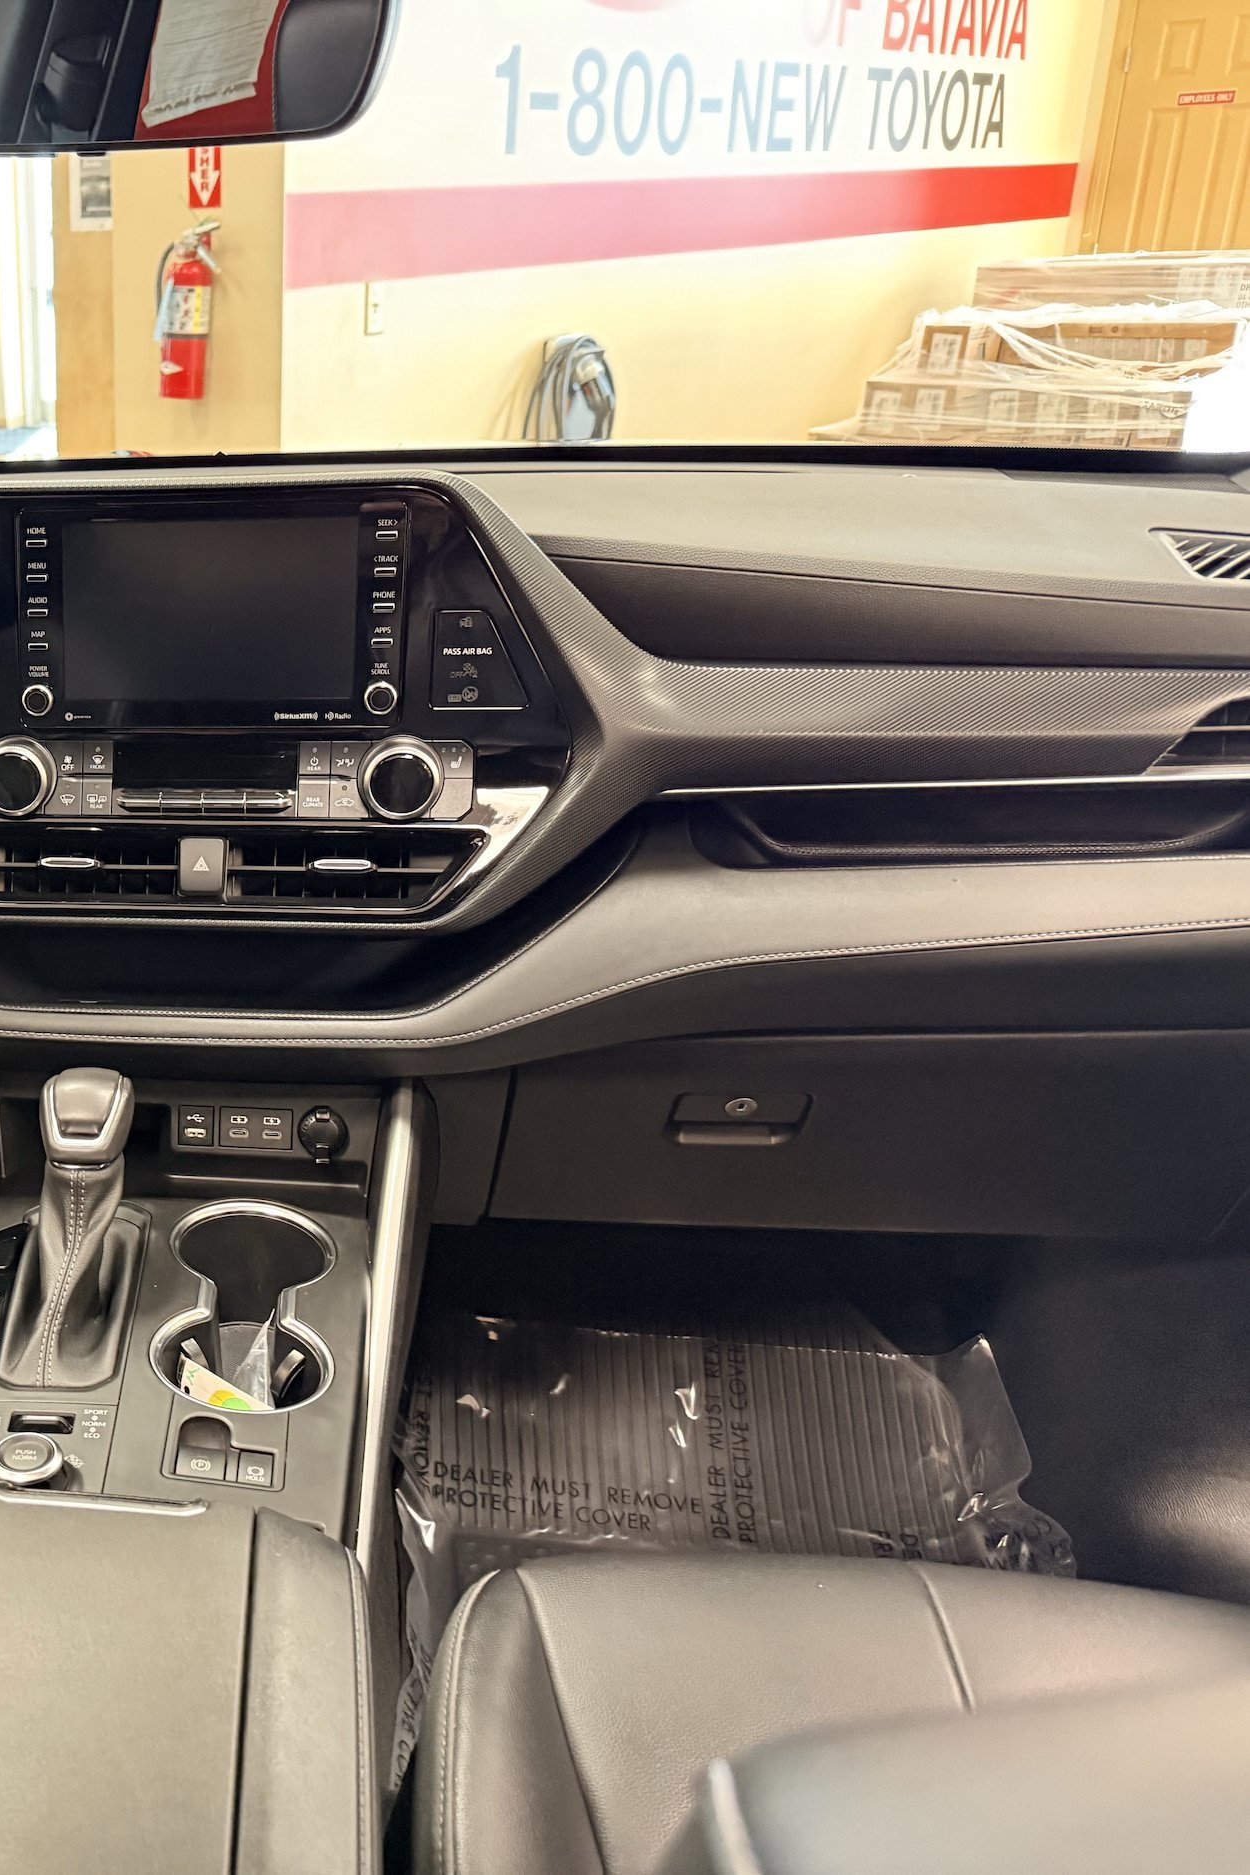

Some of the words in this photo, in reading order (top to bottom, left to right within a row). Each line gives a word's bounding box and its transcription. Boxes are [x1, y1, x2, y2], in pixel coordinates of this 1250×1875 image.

[883, 0, 1027, 60] BATAVIA
[494, 44, 848, 156] 1-800-NEW
[866, 67, 1005, 152] TOYOTA
[1179, 94, 1215, 104] EMPLOYEES
[1216, 93, 1233, 103] ONLY
[26, 527, 47, 535] HOME
[372, 590, 396, 598] PHONE
[477, 647, 492, 655] BAG
[335, 712, 352, 720] Radio
[61, 763, 75, 771] OFF
[707, 1393, 725, 1451] MUST
[245, 1474, 265, 1482] HOLD
[434, 1461, 513, 1489] DEALER
[532, 1479, 591, 1502] MUST
[608, 1487, 702, 1516] REMOVE
[731, 1420, 756, 1544] PROTECTIVE
[432, 1484, 564, 1521] PROTECTIVE
[576, 1506, 651, 1532] COVER
[709, 1465, 731, 1540] DEALER
